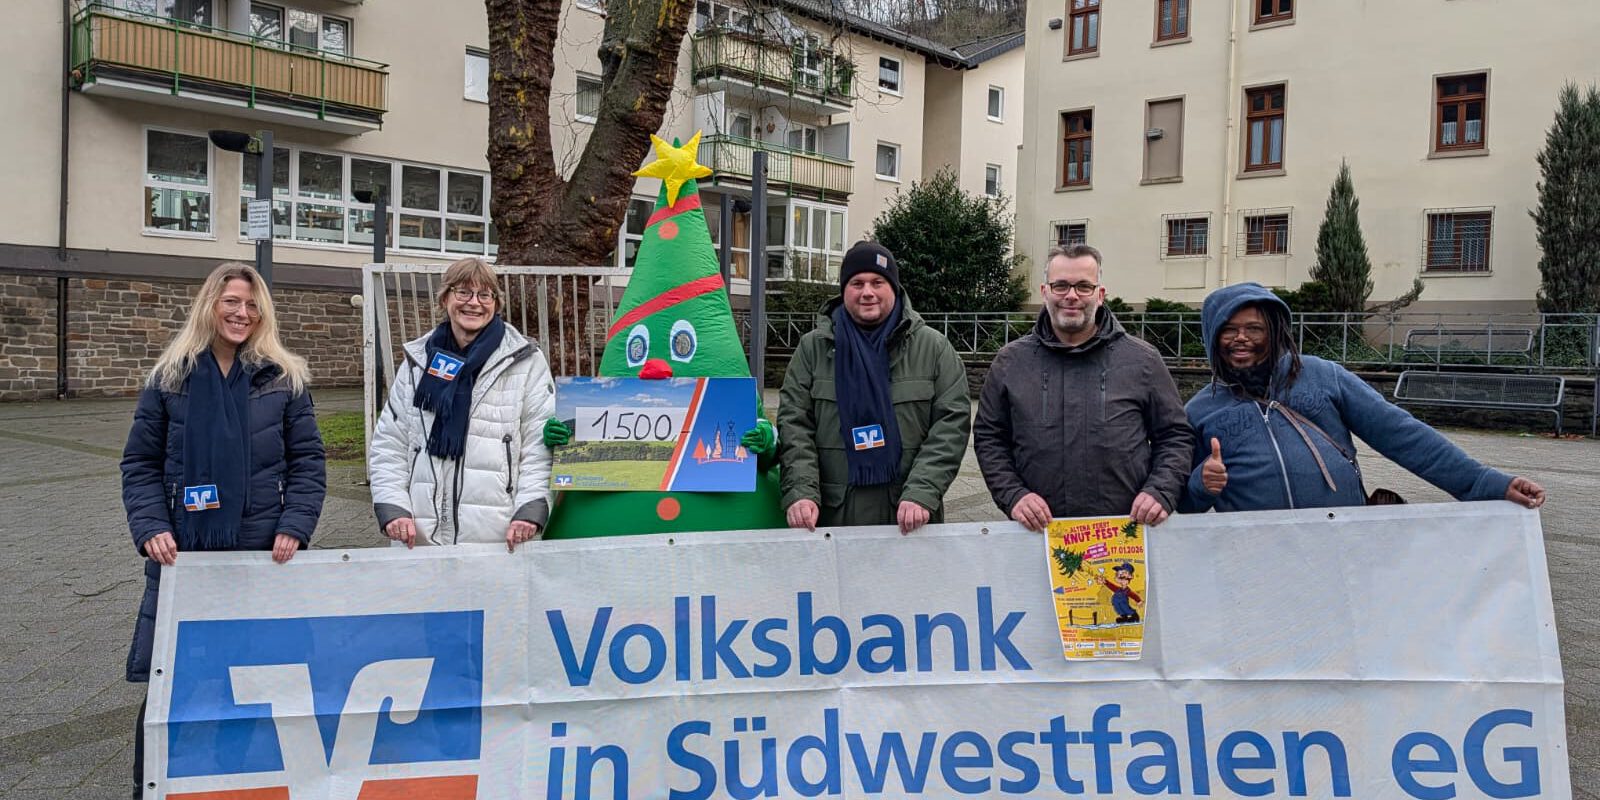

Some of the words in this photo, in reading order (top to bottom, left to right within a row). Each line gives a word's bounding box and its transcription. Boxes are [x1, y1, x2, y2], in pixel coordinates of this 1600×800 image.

[1063, 527, 1119, 546] KNUT-FEST
[545, 586, 1034, 687] Volksbank
[546, 722, 629, 800] in
[666, 703, 1352, 800] Südwestfalen
[1391, 708, 1542, 800] eG
